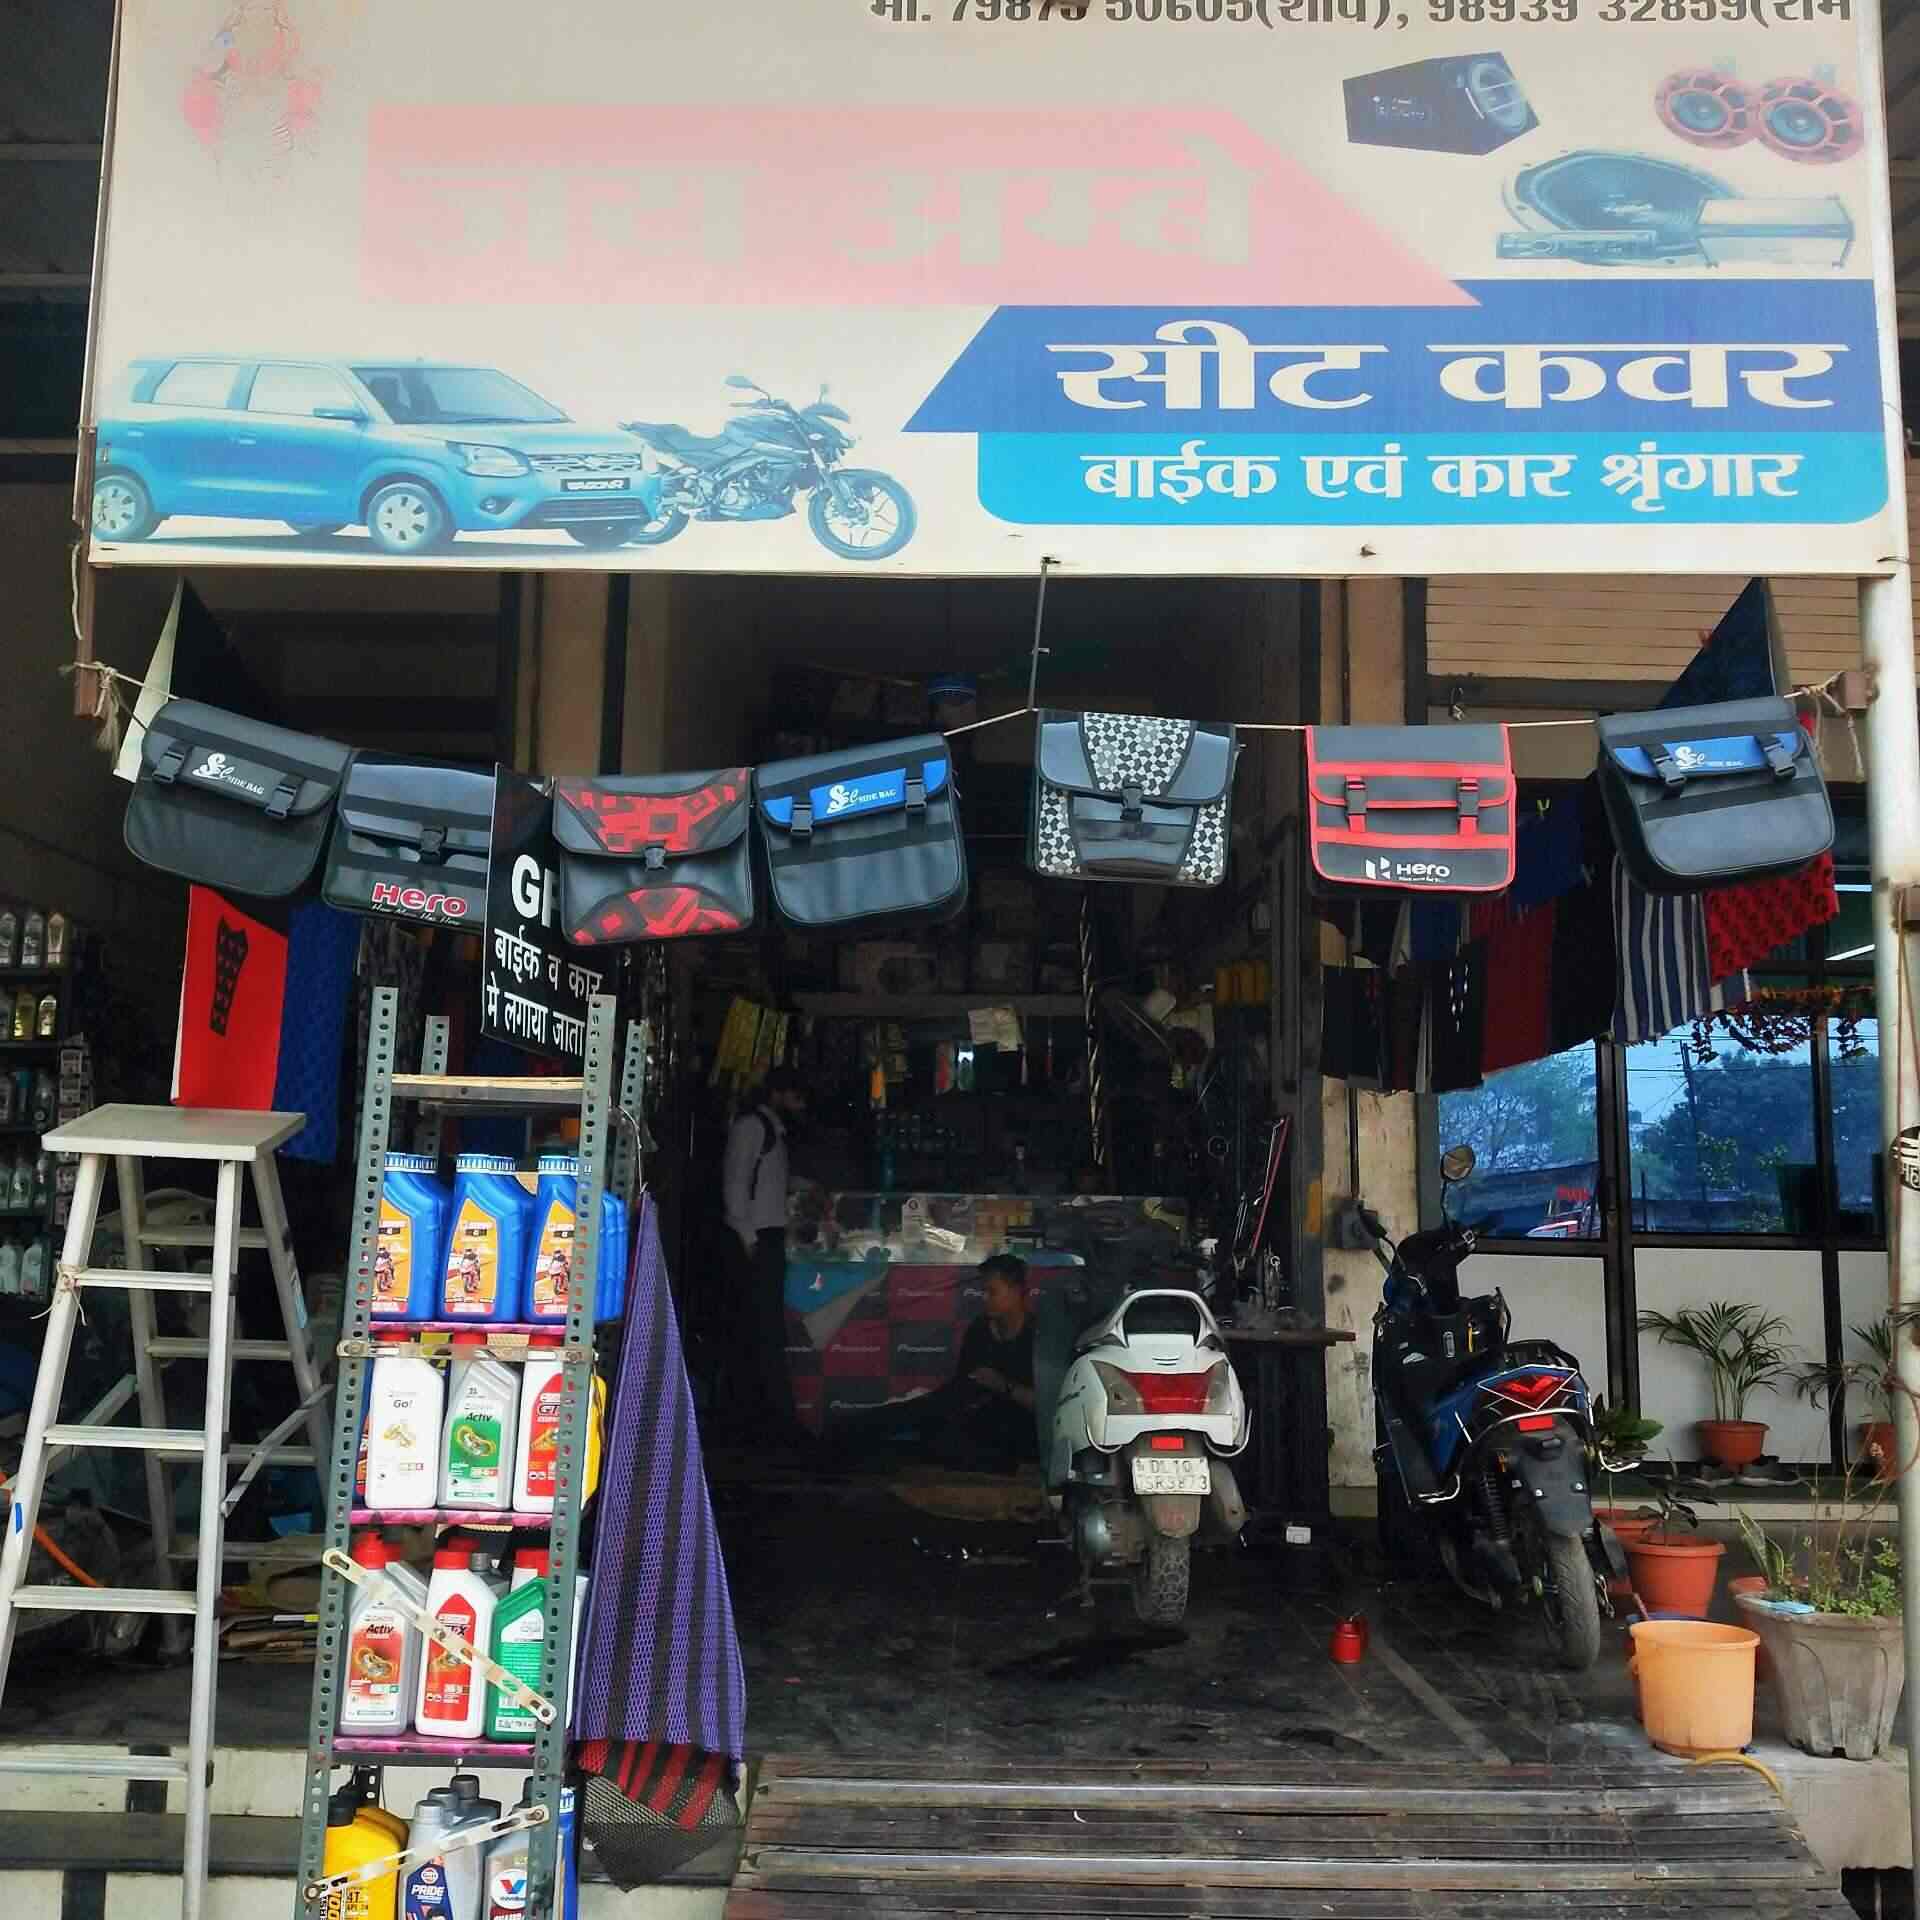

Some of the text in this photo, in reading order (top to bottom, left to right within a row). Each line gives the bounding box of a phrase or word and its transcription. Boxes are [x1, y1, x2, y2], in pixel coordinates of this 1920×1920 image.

[1045, 319, 1850, 410] सीट कवर
[1080, 440, 1280, 504] बाईक
[1304, 442, 1408, 498] एवं
[1429, 454, 1578, 498] कार
[1396, 863, 1451, 878] Hero
[371, 882, 467, 917] Hero
[494, 924, 542, 983] बाईक
[547, 954, 561, 991] व
[503, 991, 549, 1044] लगाया
[552, 1010, 585, 1057] जाता
[465, 1412, 493, 1423] Activ
[366, 1623, 394, 1634] Activ
[411, 1884, 445, 1897] PRIDE
